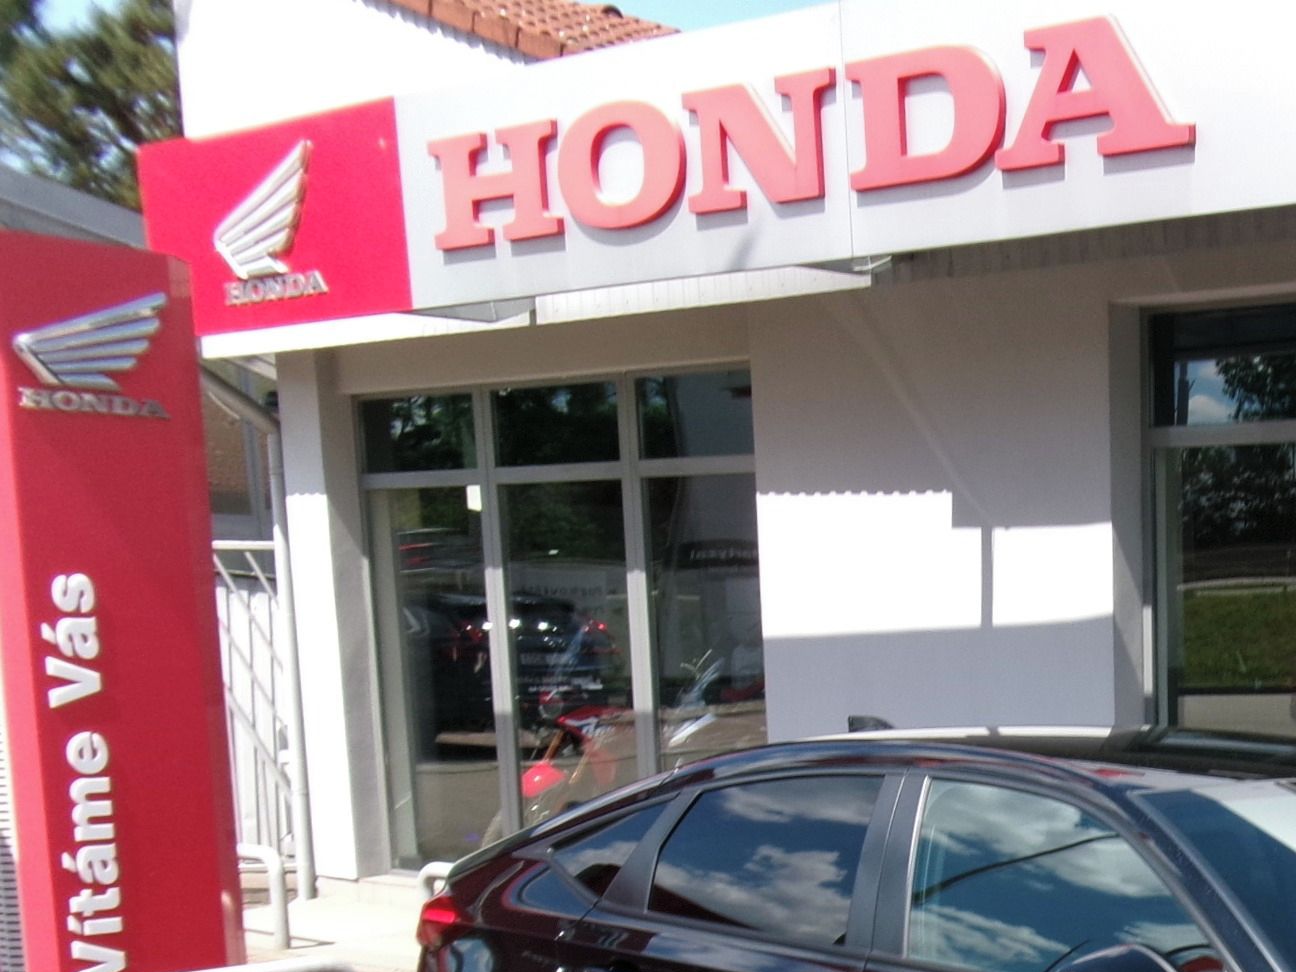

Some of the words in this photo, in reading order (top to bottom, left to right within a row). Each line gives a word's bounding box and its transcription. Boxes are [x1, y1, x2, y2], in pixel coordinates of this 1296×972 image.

[427, 14, 1195, 251] HONDA
[224, 269, 328, 306] HONDA
[17, 387, 171, 420] HONDA
[41, 572, 102, 709] Vás
